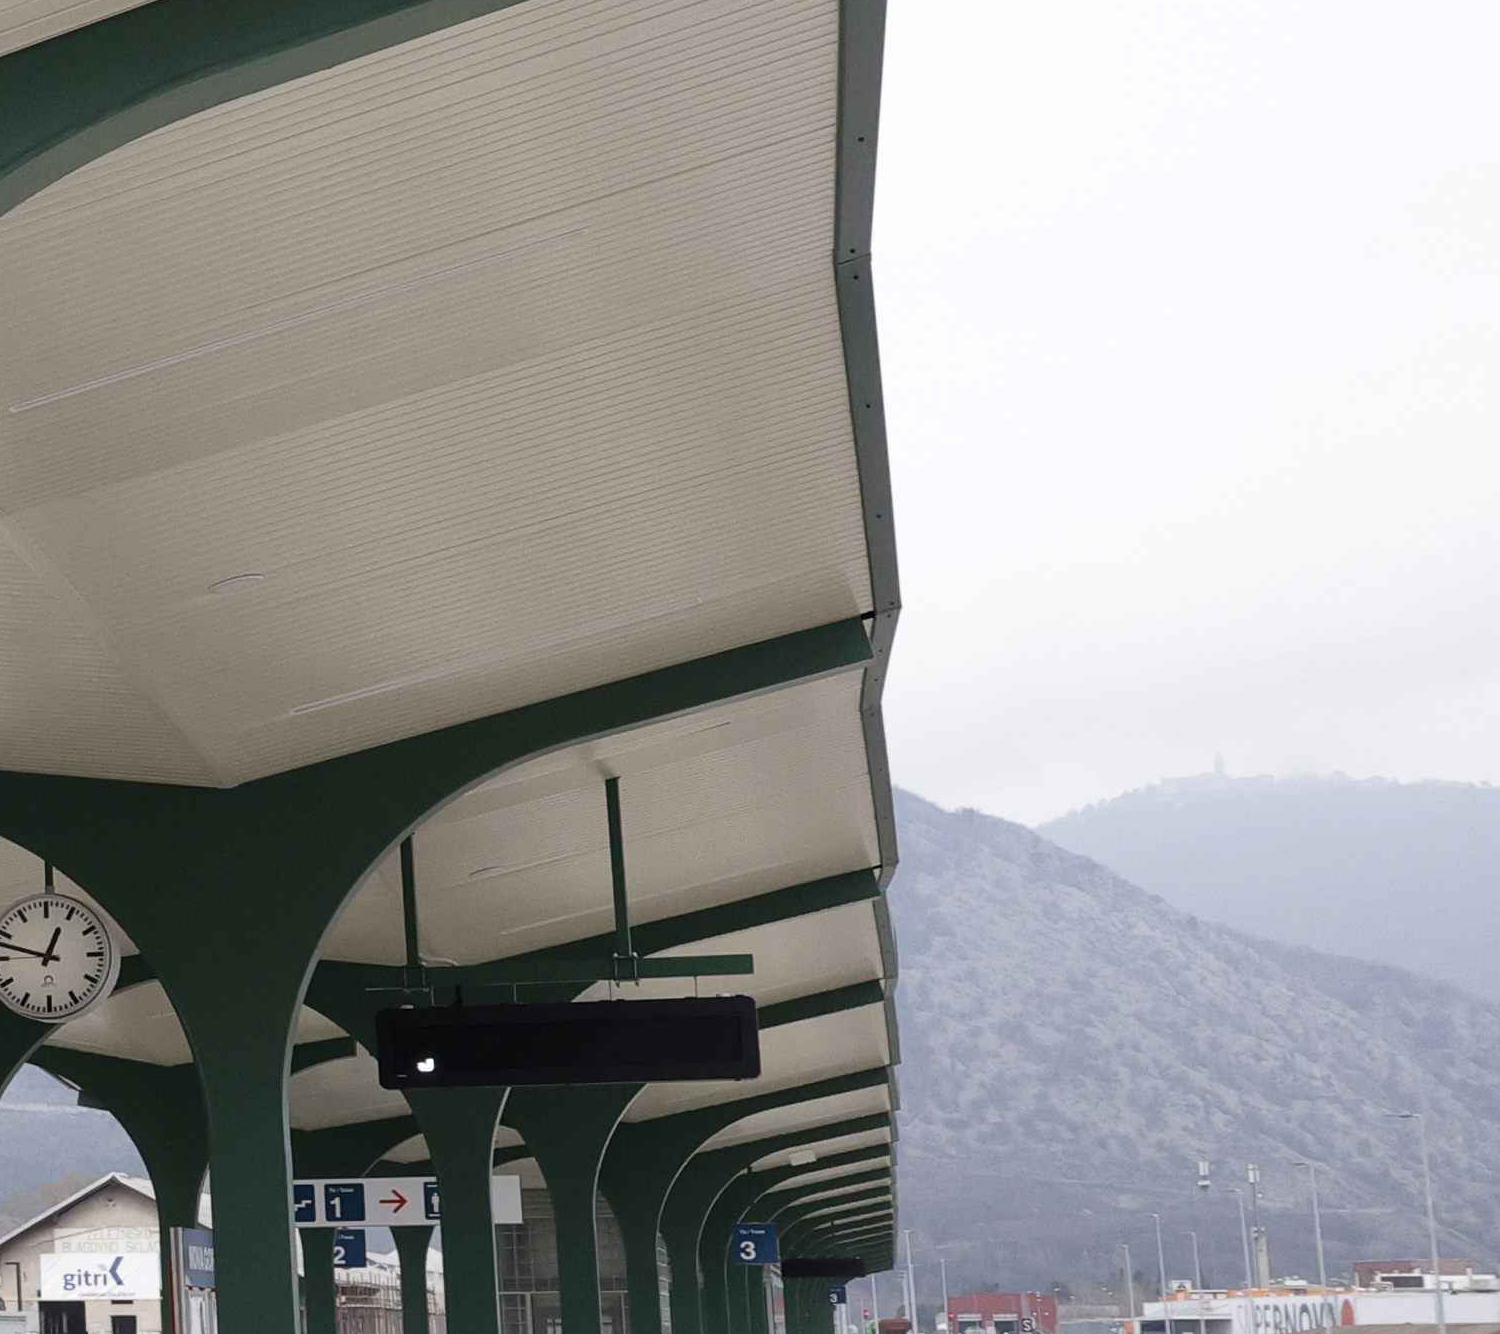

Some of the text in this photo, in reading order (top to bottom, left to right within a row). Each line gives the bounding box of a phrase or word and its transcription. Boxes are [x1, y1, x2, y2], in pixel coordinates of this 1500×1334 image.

[330, 1197, 341, 1218] 1
[333, 1246, 346, 1265] 2
[740, 1241, 756, 1260] 3
[1023, 1319, 1032, 1331] S
